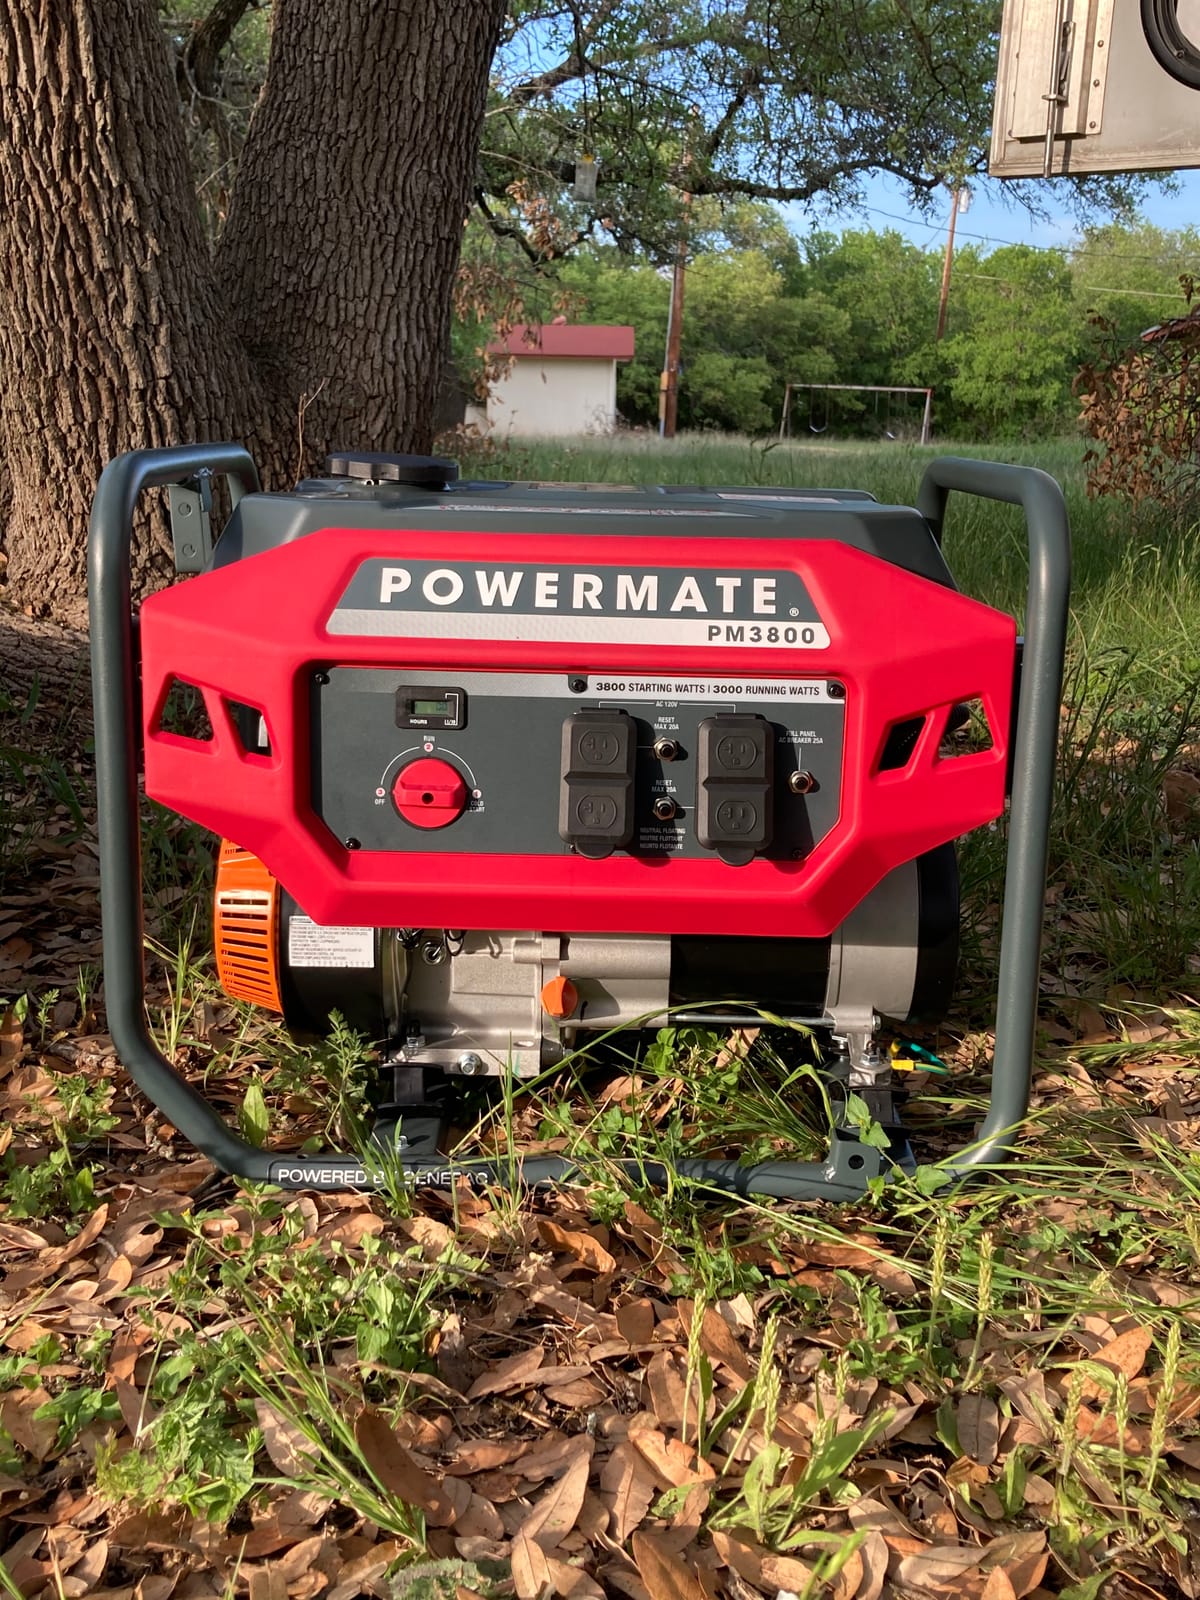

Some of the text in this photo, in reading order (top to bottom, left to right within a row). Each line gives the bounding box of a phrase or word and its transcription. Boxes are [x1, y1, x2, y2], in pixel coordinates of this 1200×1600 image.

[380, 567, 777, 614] POWERMATE
[707, 625, 815, 644] PM3800
[596, 682, 820, 696] 3800 STARTING WATTS 3000 RUNNING WATTS
[278, 1168, 367, 1184] POWERED
